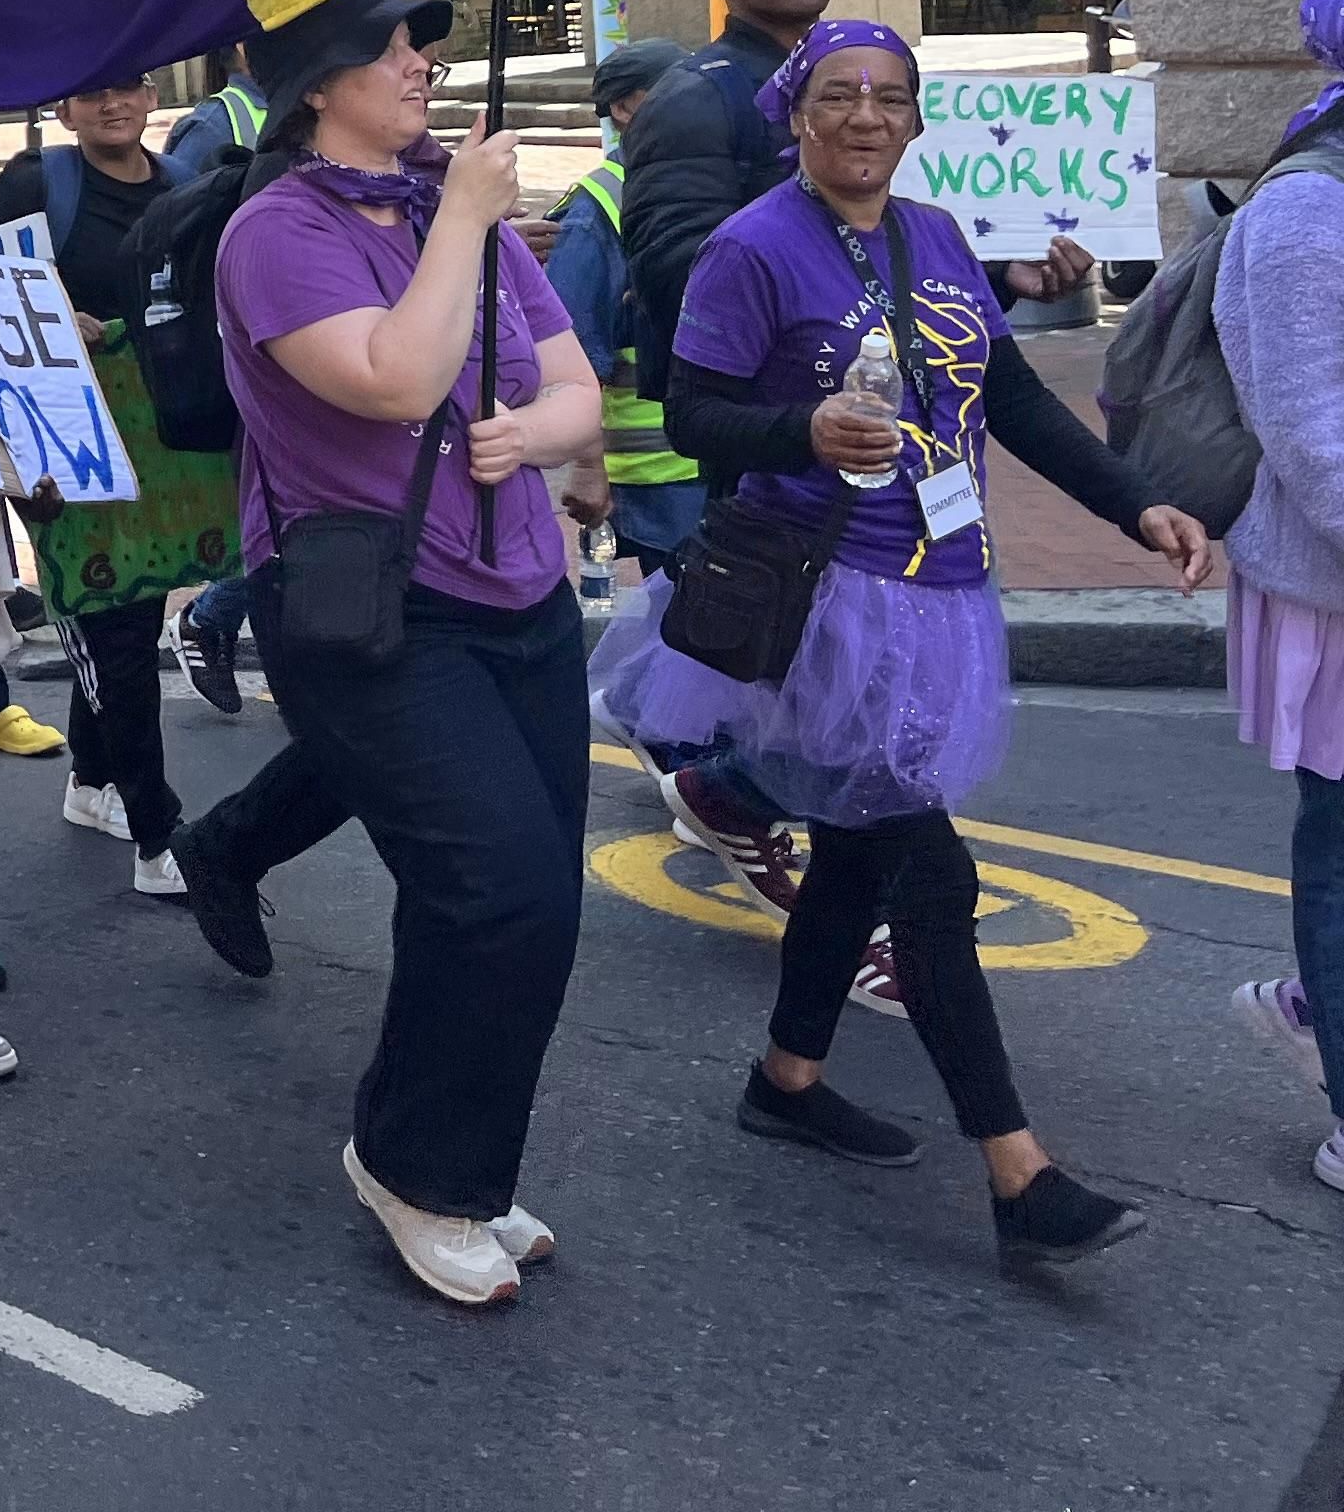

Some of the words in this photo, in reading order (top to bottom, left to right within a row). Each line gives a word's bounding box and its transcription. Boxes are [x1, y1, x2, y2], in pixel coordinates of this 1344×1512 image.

[923, 81, 1133, 136] ECOVERY
[918, 147, 1129, 211] WORKS
[925, 486, 972, 517] COMMITTEE
